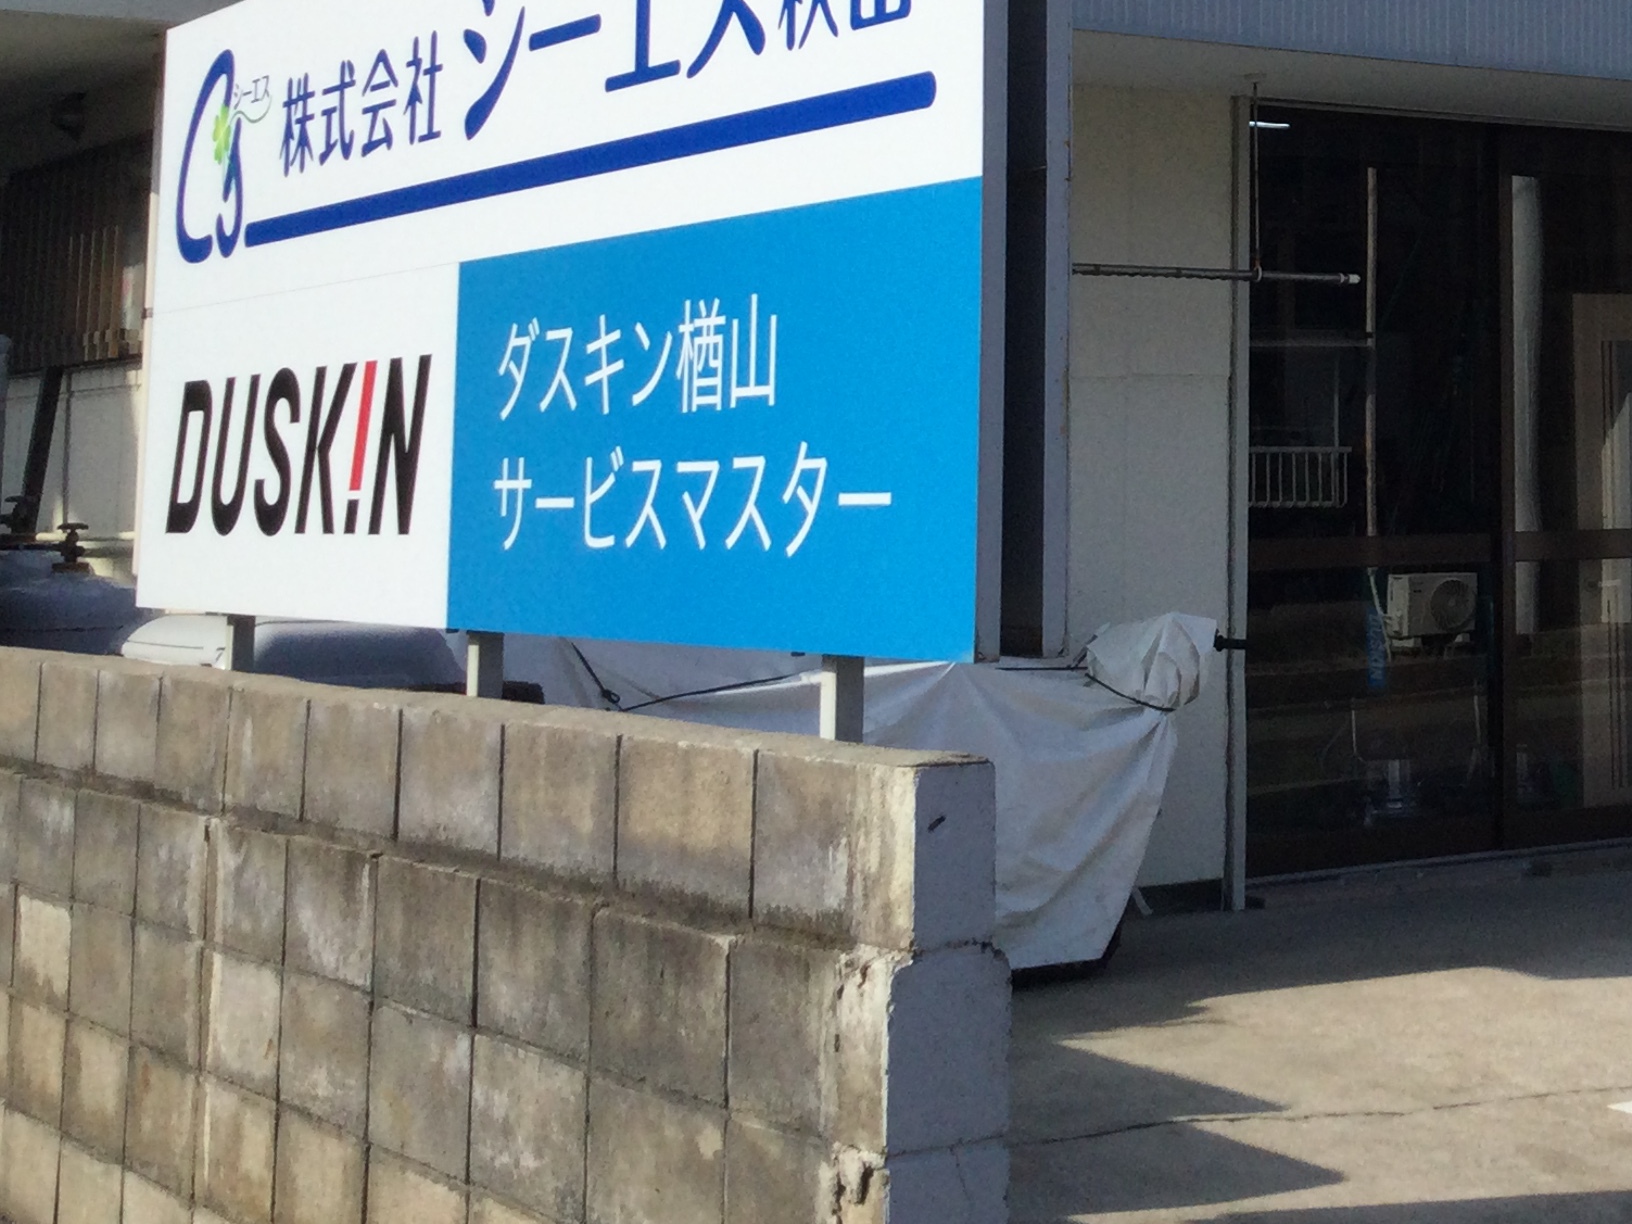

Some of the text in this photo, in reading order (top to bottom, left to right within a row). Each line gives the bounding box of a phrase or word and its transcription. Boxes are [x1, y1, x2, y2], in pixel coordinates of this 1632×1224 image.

[233, 75, 270, 110] シーエス
[498, 293, 777, 421] ダスキン楢山
[494, 441, 892, 558] サービスマスター
